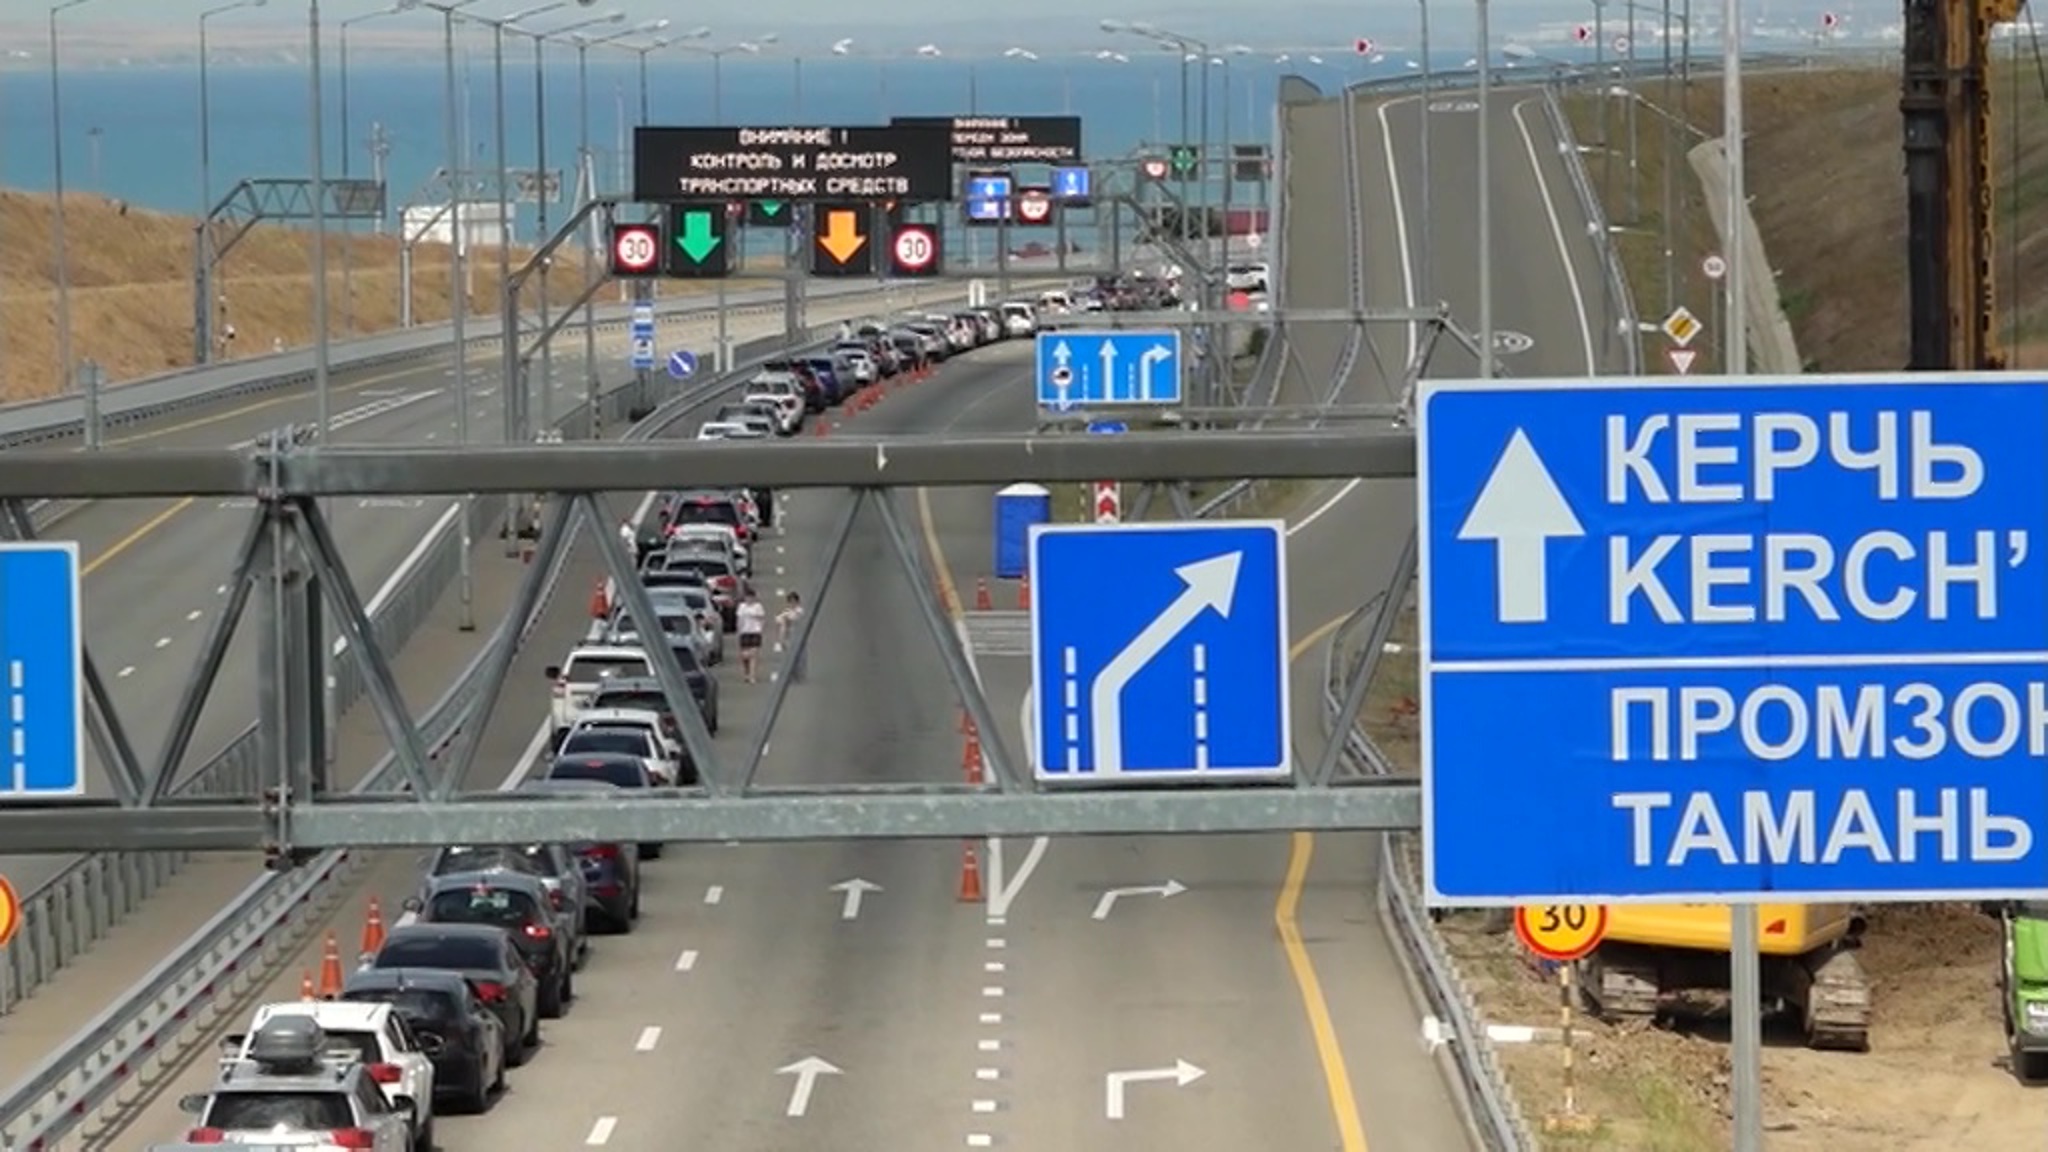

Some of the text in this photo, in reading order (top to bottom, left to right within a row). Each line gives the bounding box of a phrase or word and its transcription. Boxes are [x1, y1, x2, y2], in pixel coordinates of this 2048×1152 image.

[739, 129, 831, 146] ВНИМАНИЕ
[690, 153, 898, 171] КОНТРОЛЬ И ДОСМОТР
[990, 147, 1074, 159] БЕЗОПАСНОСТИ
[680, 178, 909, 195] ТРАНСПОРТНЫХ СРЕДСТВ
[624, 238, 649, 260] 30
[903, 237, 927, 260] 30
[1606, 410, 1985, 503] КЕРЧЬ
[1609, 530, 2028, 625] KERCH'
[1611, 787, 2034, 867] ТАМАНЬ
[1540, 904, 1586, 932] 30
